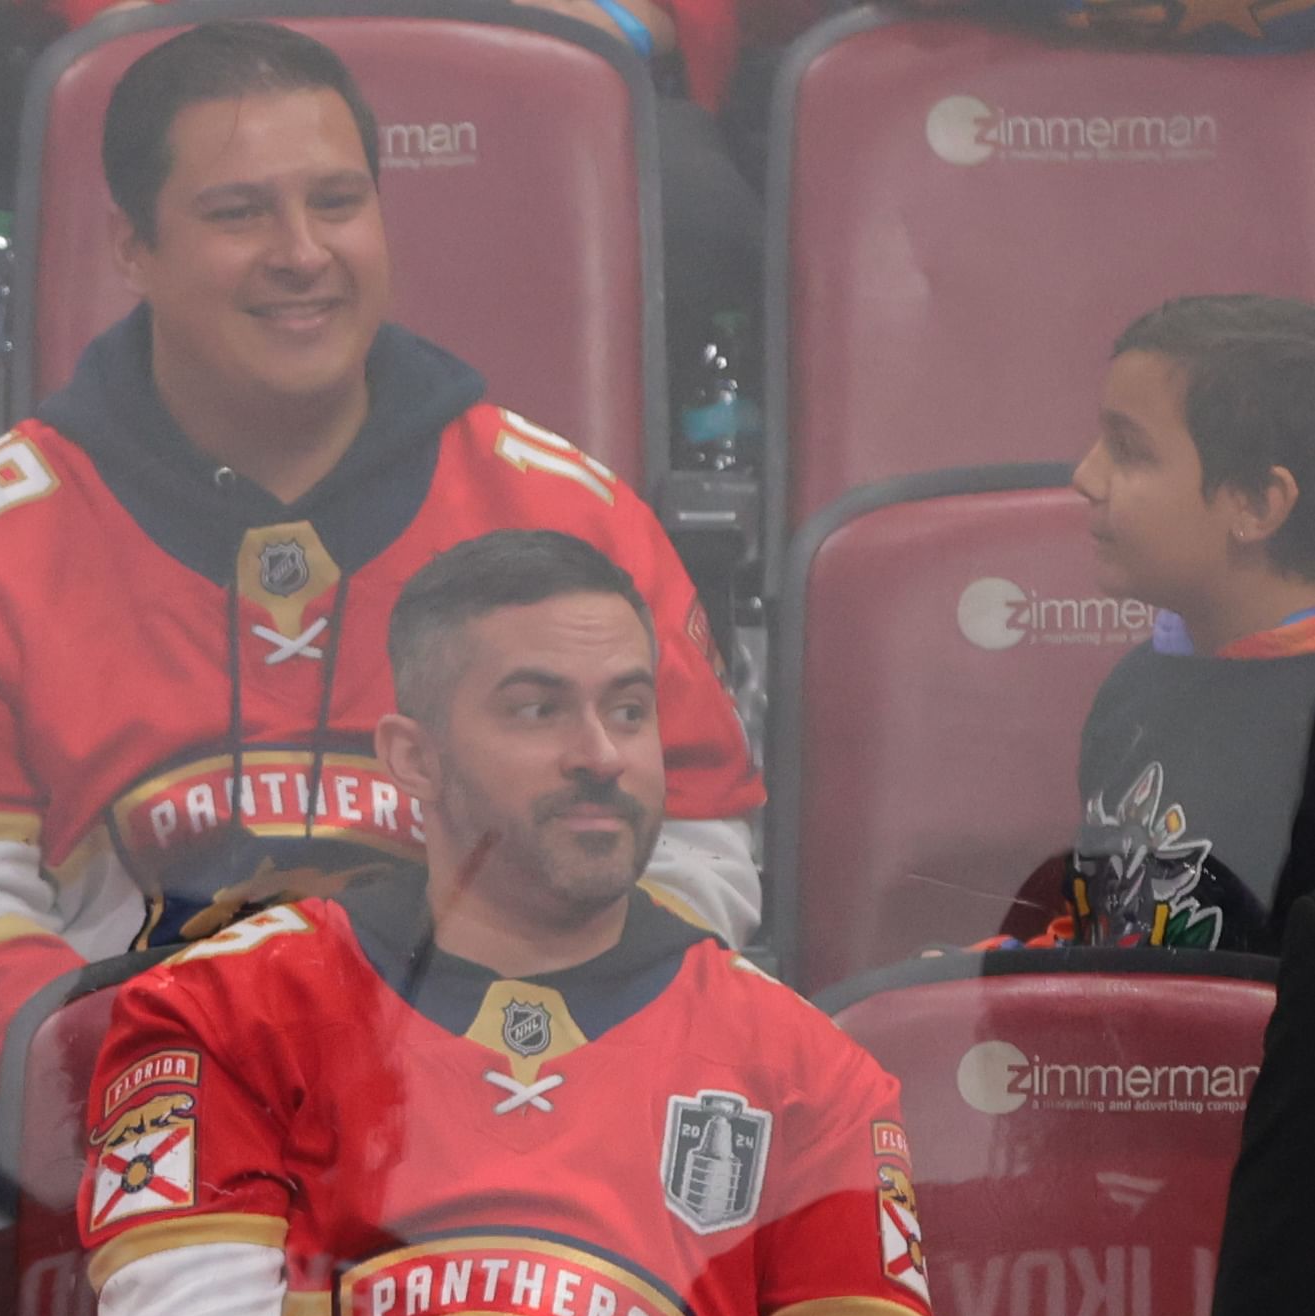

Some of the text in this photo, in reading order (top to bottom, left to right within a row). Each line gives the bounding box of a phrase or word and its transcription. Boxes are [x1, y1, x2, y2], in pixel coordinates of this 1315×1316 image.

[974, 107, 1216, 149] zimmerman
[514, 1018, 540, 1041] NHL
[114, 1057, 187, 1101] FLORIDA
[680, 1123, 698, 1138] 20
